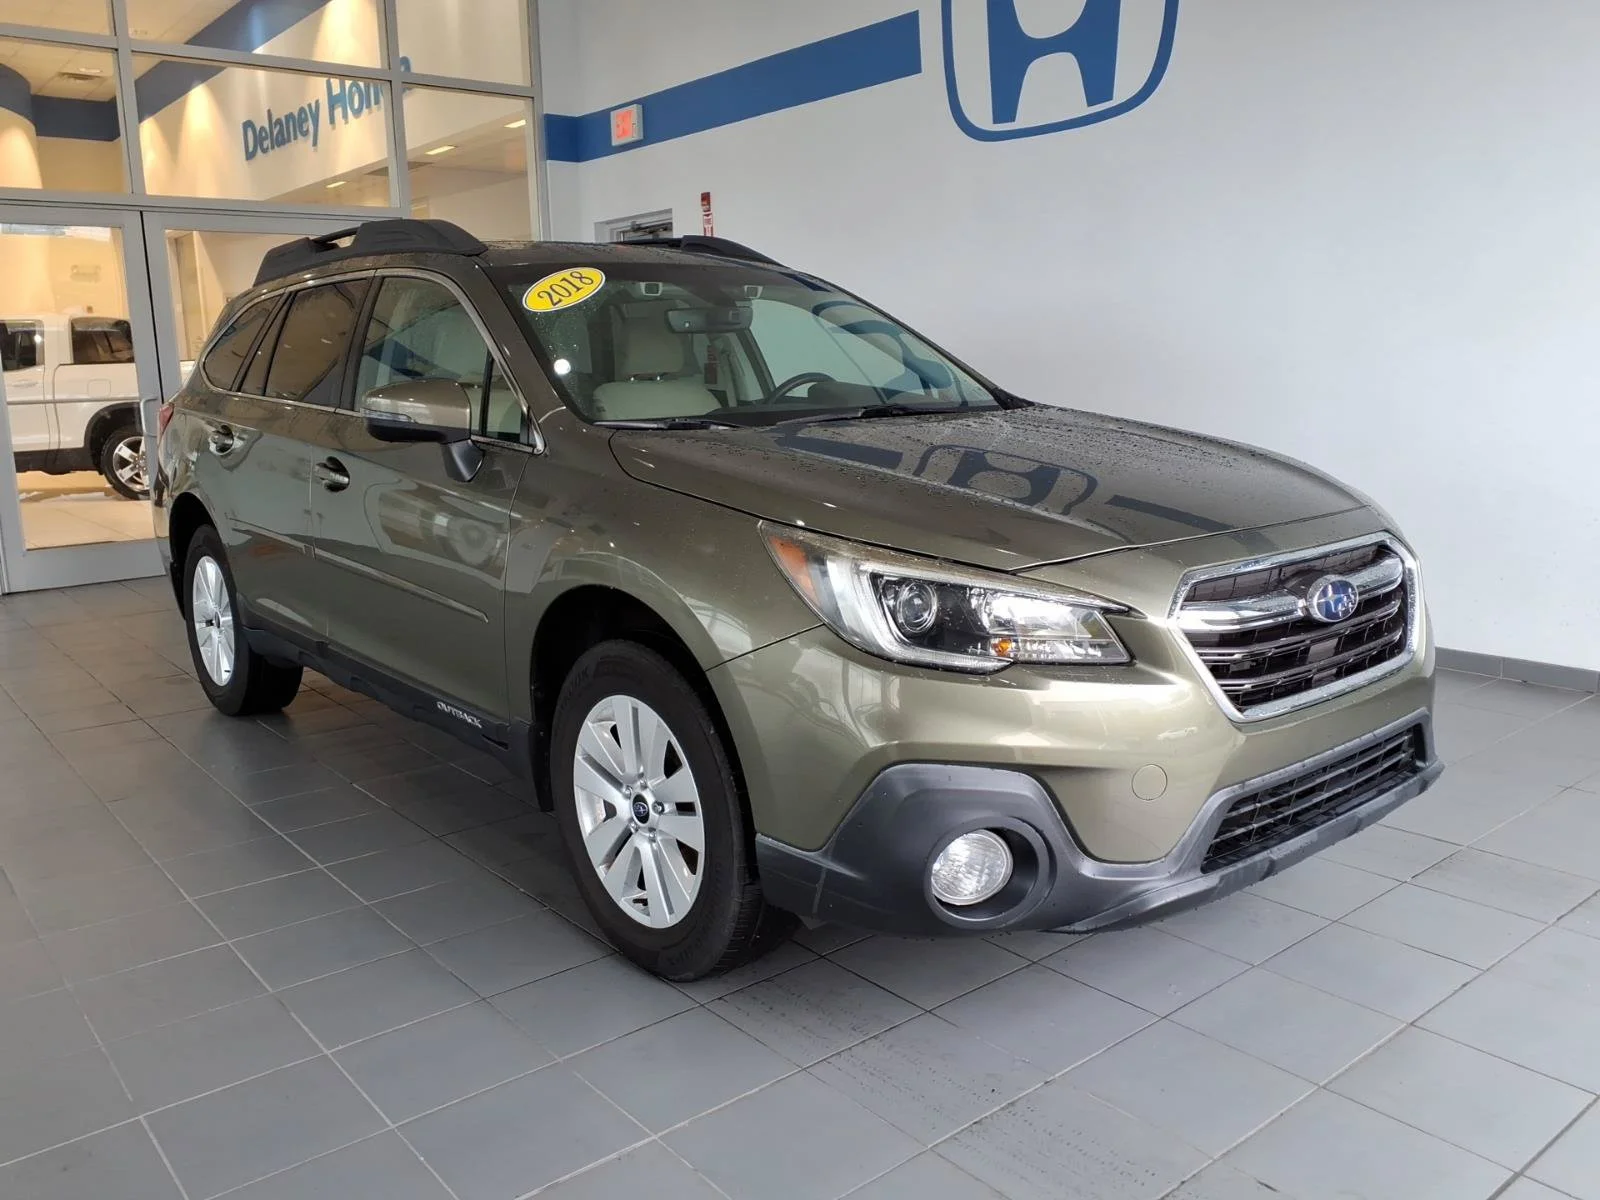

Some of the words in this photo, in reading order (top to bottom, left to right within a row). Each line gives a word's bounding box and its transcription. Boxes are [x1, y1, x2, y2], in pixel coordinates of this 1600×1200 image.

[242, 98, 320, 161] Delaney
[325, 56, 413, 126] Hon
[537, 270, 595, 307] 2018
